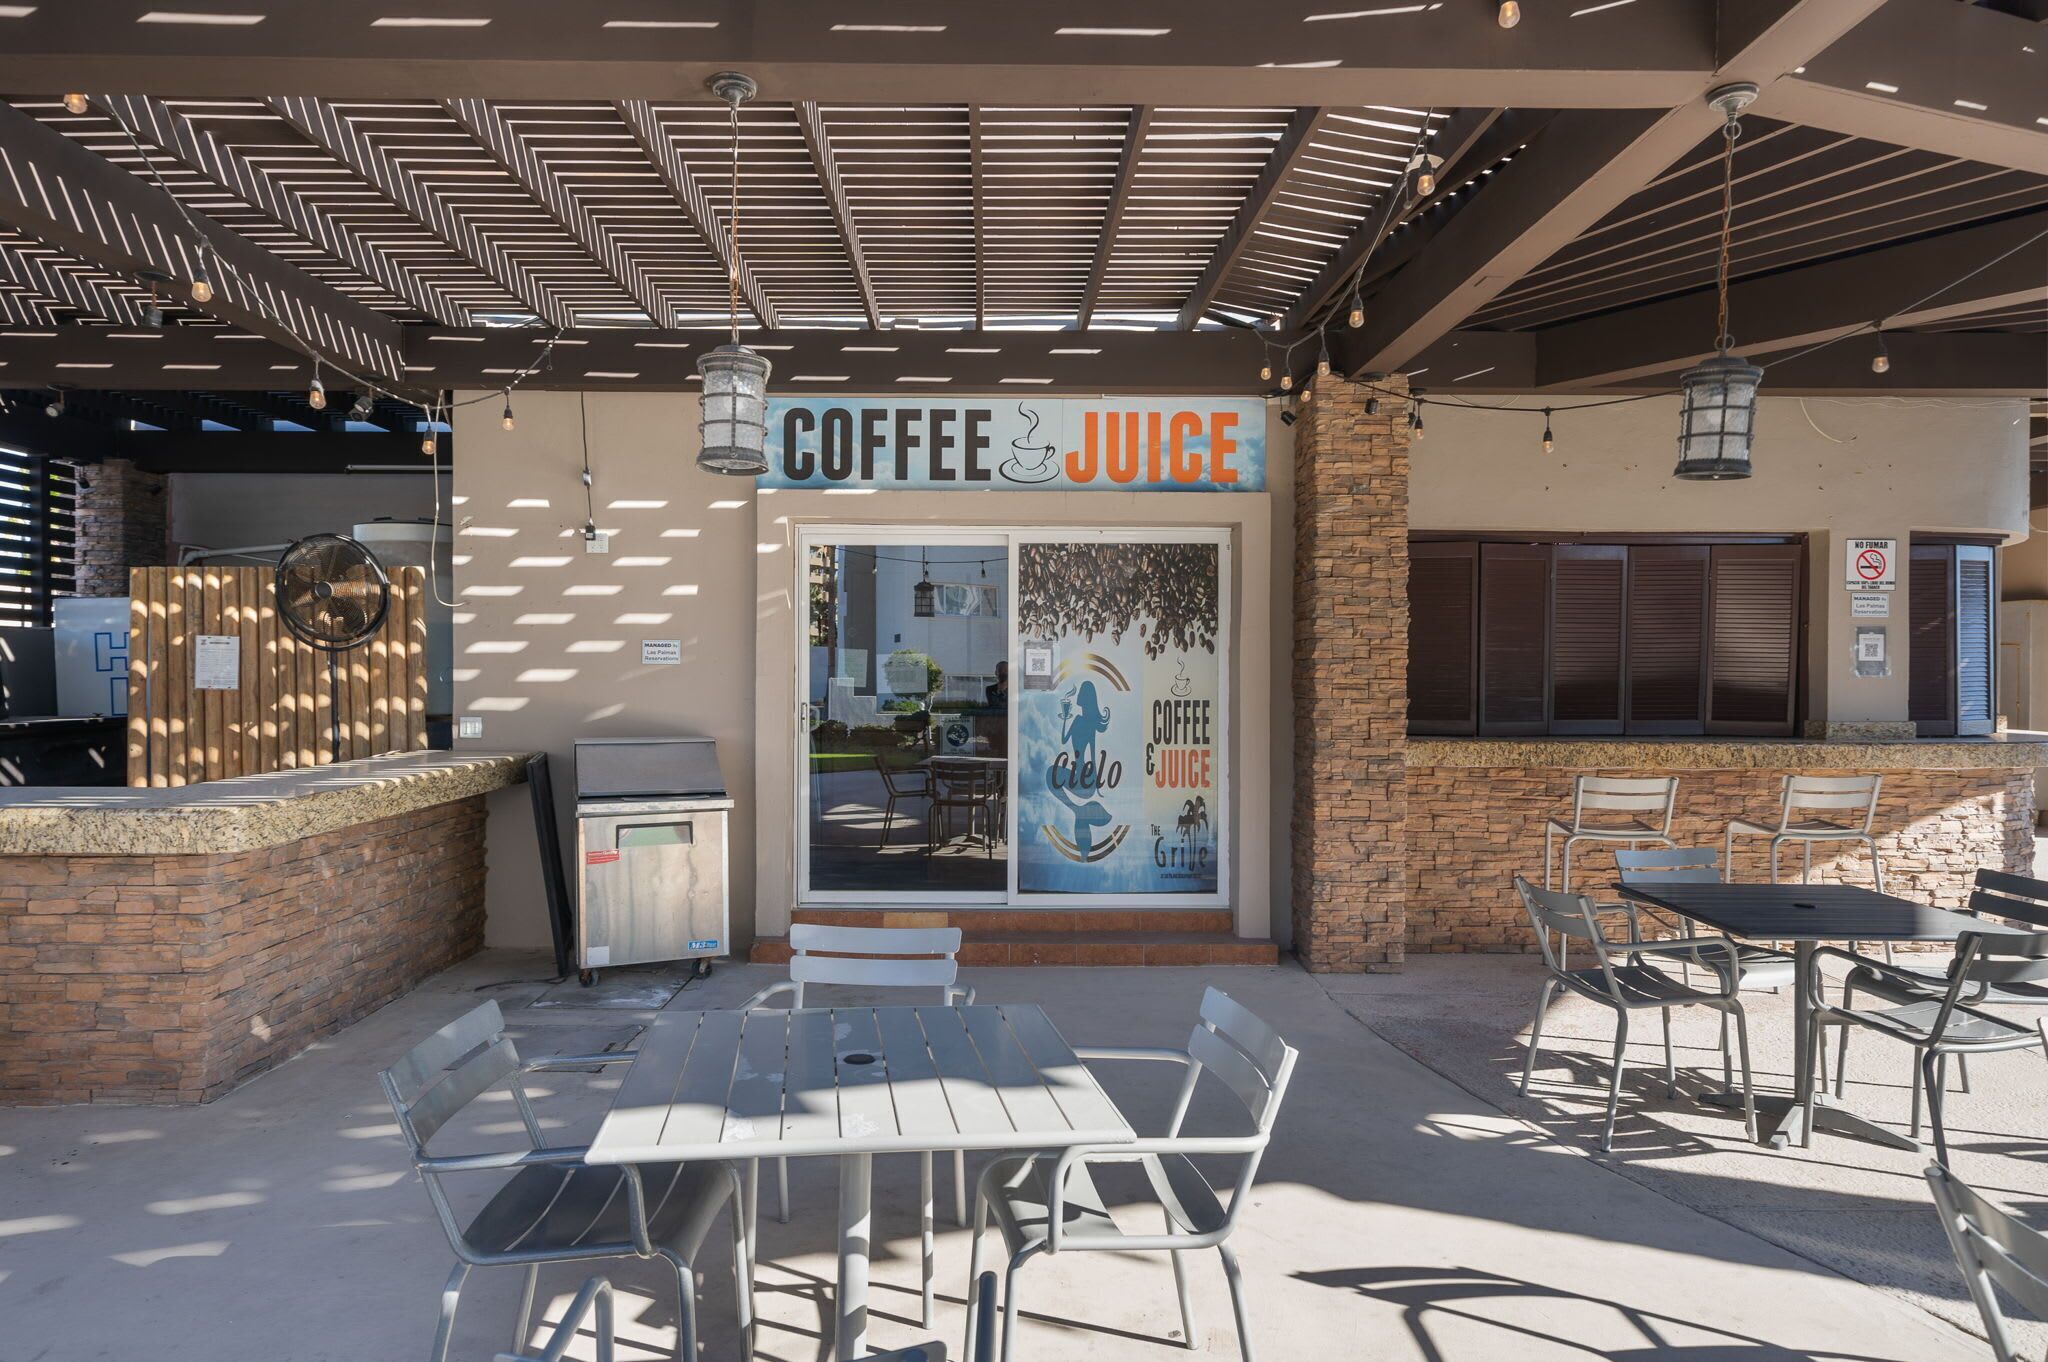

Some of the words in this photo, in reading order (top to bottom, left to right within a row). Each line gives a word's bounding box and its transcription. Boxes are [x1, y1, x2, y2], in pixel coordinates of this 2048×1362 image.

[783, 407, 992, 482] COFFEE
[1065, 410, 1239, 484] JUICE
[1855, 541, 1864, 549] NO
[1866, 541, 1888, 549] FUMAR
[1152, 699, 1210, 745] COFFEE
[1051, 750, 1122, 790] Cielo
[1146, 742, 1155, 776] &
[1155, 749, 1211, 789] JUICE
